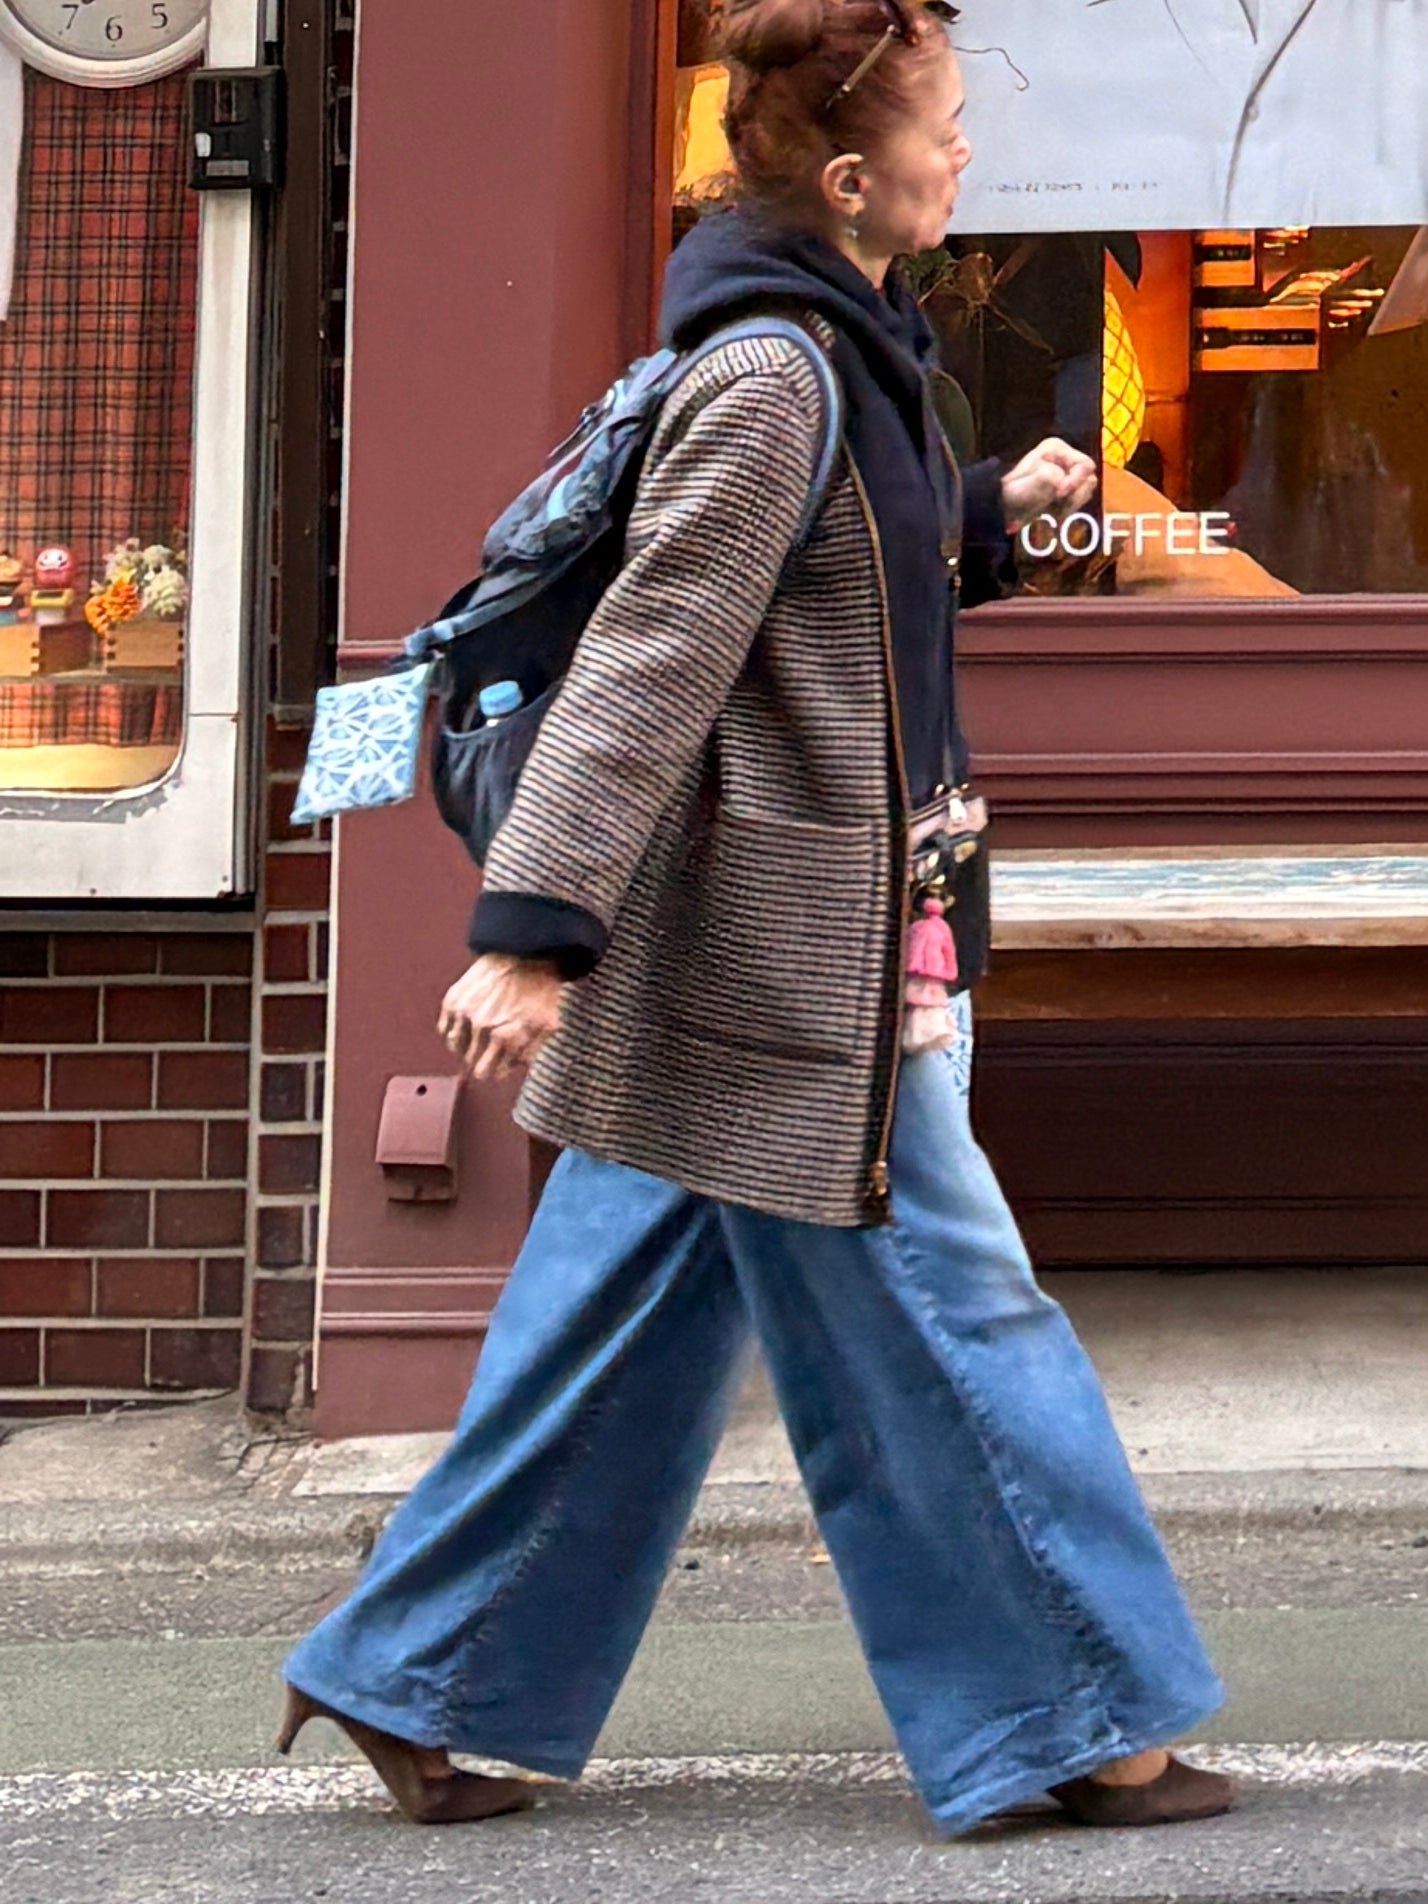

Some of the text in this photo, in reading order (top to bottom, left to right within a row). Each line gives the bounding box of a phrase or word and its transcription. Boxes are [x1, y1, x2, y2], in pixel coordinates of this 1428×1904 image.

[61, 4, 80, 30] 7
[105, 16, 123, 41] 6
[151, 3, 169, 29] 5
[1020, 511, 1231, 557] COFFEE
